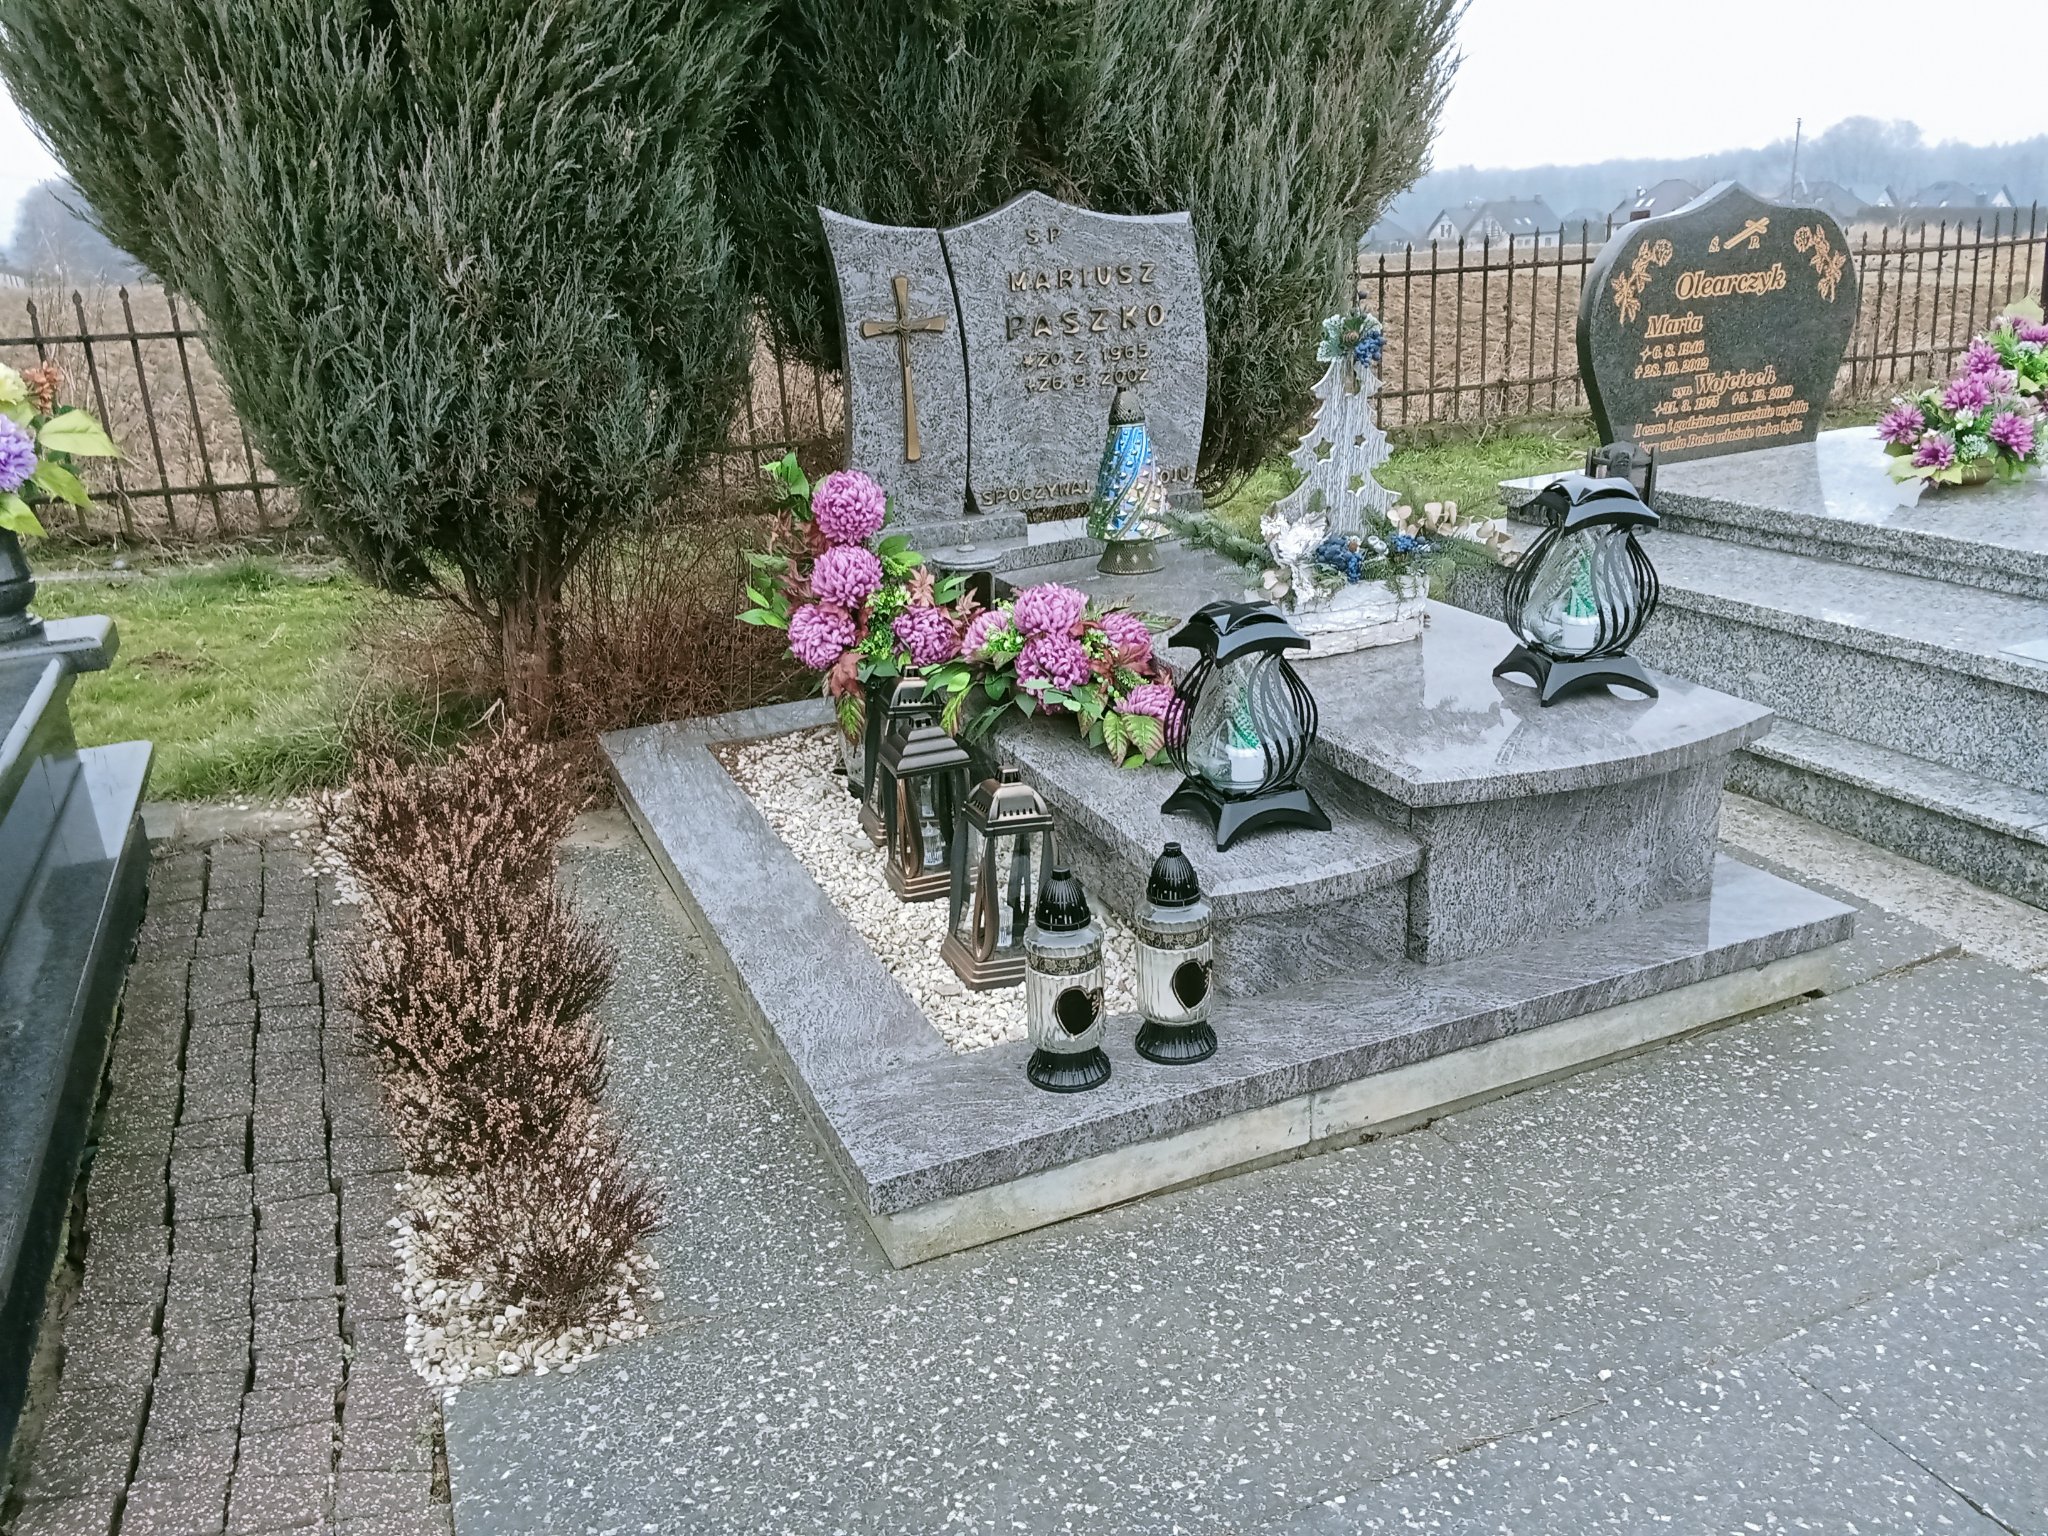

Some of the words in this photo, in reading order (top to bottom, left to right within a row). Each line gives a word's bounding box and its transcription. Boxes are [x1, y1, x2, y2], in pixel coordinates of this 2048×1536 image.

[1009, 261, 1156, 293] MARIUSZ
[1675, 262, 1787, 300] Olearczyk
[1005, 303, 1165, 341] PASZKO
[1644, 311, 1704, 338] Maria
[1100, 344, 1149, 362] 1965
[1678, 340, 1705, 356] 1946
[1100, 367, 1151, 386] 2002
[1663, 360, 1680, 376] 10.
[1680, 357, 1709, 374] 2002
[1672, 386, 1693, 399] syn
[1694, 365, 1777, 396] Wojciech
[1694, 395, 1721, 411] 1975
[1632, 423, 1643, 439] I
[1641, 423, 1667, 437] czas
[1672, 414, 1717, 434] godzina
[1715, 413, 1730, 426] za
[1730, 404, 1775, 424] wcześnie
[1660, 435, 1687, 453] wola
[1686, 431, 1715, 449] Boża
[1754, 422, 1780, 438] taka
[981, 480, 1091, 506] SPOCZYWAJ
